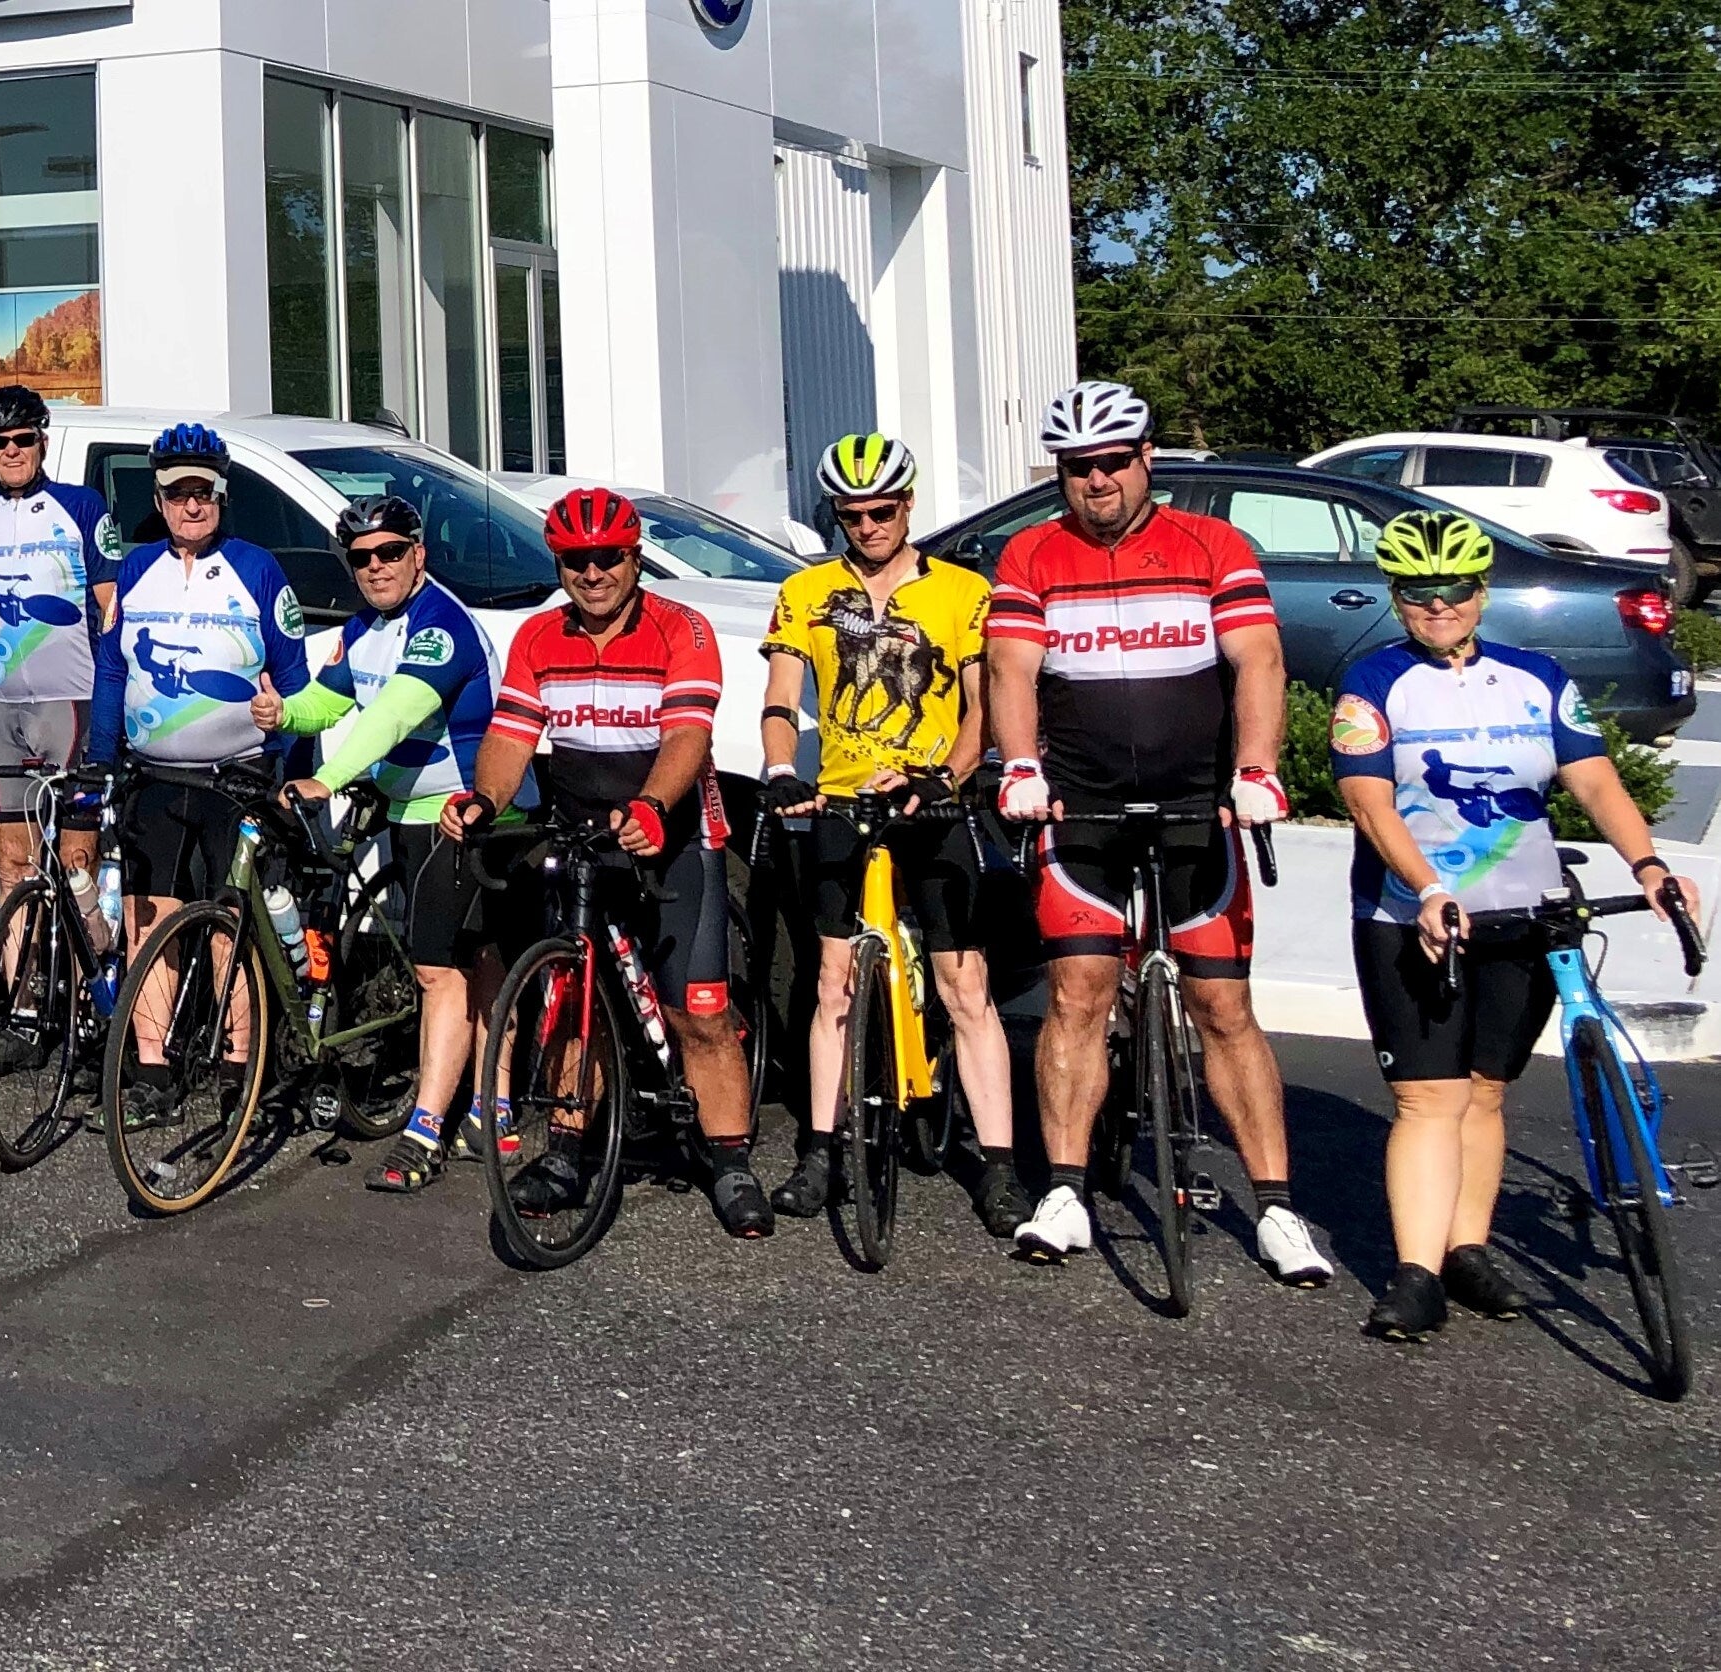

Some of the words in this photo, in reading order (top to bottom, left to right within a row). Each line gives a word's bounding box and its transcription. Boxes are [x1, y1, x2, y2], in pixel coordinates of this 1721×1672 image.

[1045, 629, 1093, 653] Pro
[1096, 620, 1206, 652] Pedals
[575, 705, 663, 728] Pedals
